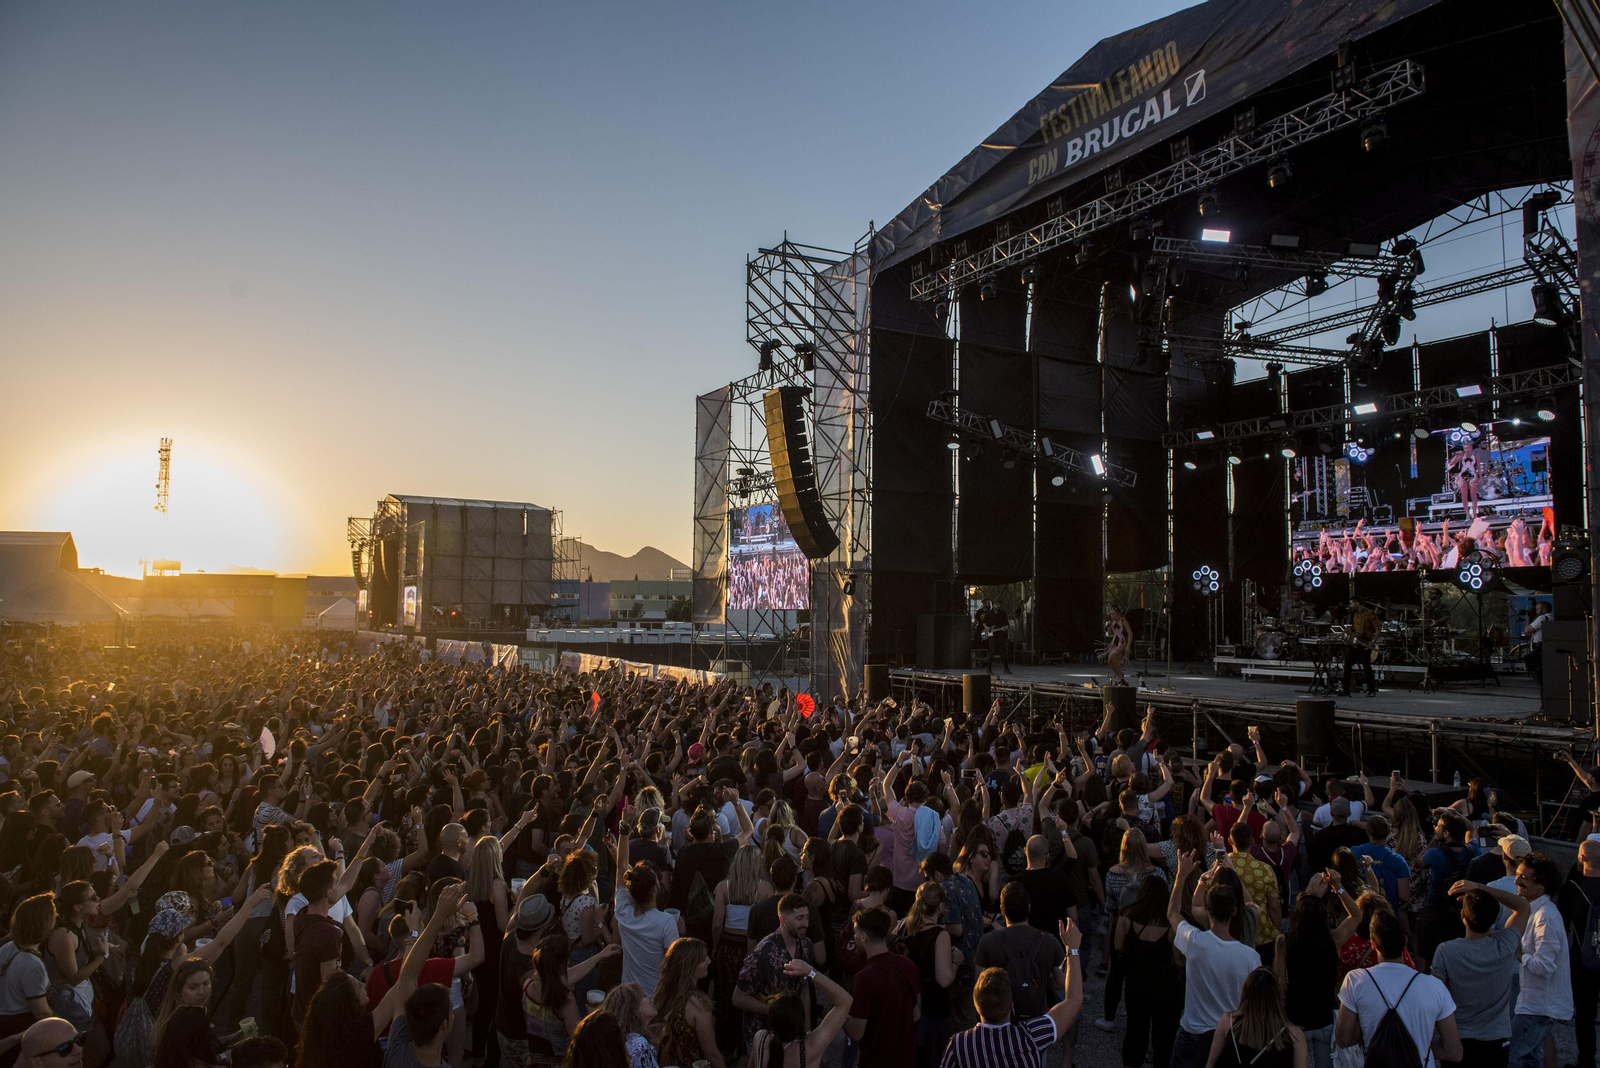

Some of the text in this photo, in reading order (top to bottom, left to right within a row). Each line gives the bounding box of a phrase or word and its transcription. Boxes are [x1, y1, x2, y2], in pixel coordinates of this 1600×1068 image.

[1027, 88, 1180, 185] CON BRUGAL
[1039, 40, 1180, 144] FESTIVALEANDO
